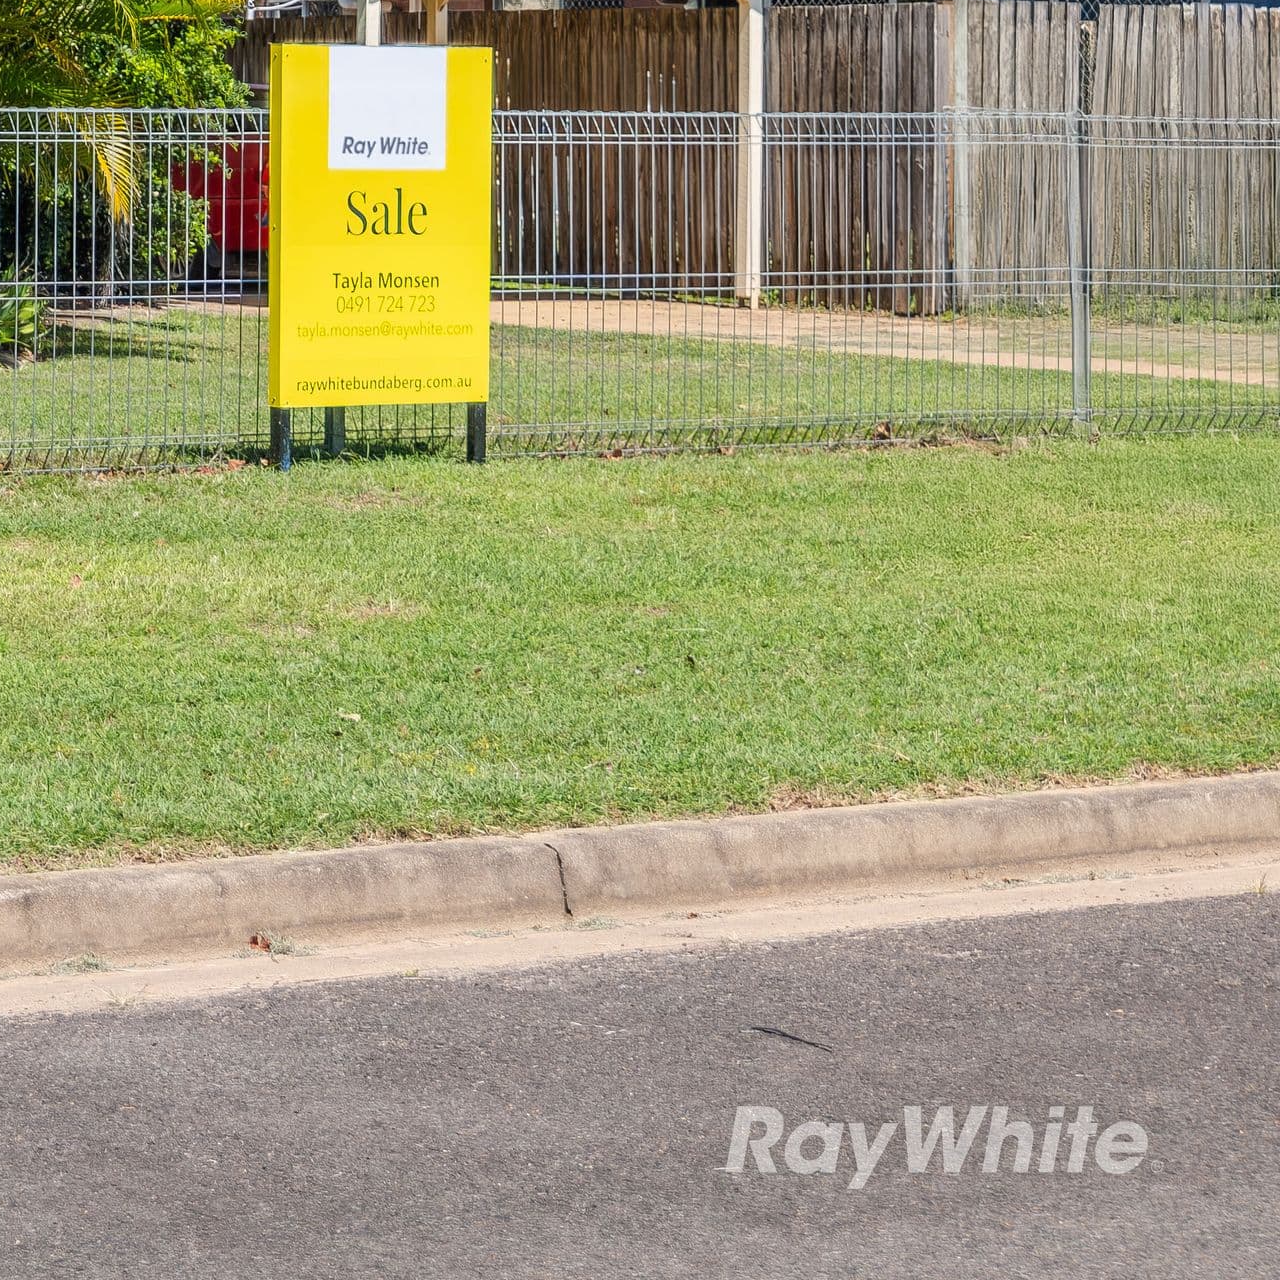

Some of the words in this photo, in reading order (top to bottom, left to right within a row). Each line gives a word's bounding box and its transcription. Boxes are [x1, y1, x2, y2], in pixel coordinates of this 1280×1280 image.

[342, 136, 376, 158] Ray
[380, 136, 429, 155] White
[346, 187, 428, 236] Sale
[332, 271, 373, 293] Tayla
[378, 272, 440, 289] Monsen
[336, 296, 372, 314] 0491
[377, 296, 404, 313] 724
[409, 295, 435, 313] 723
[297, 321, 474, 341] tayla.monsen@raywhite.com
[297, 375, 473, 394] raywhitebundaberg.com.au
